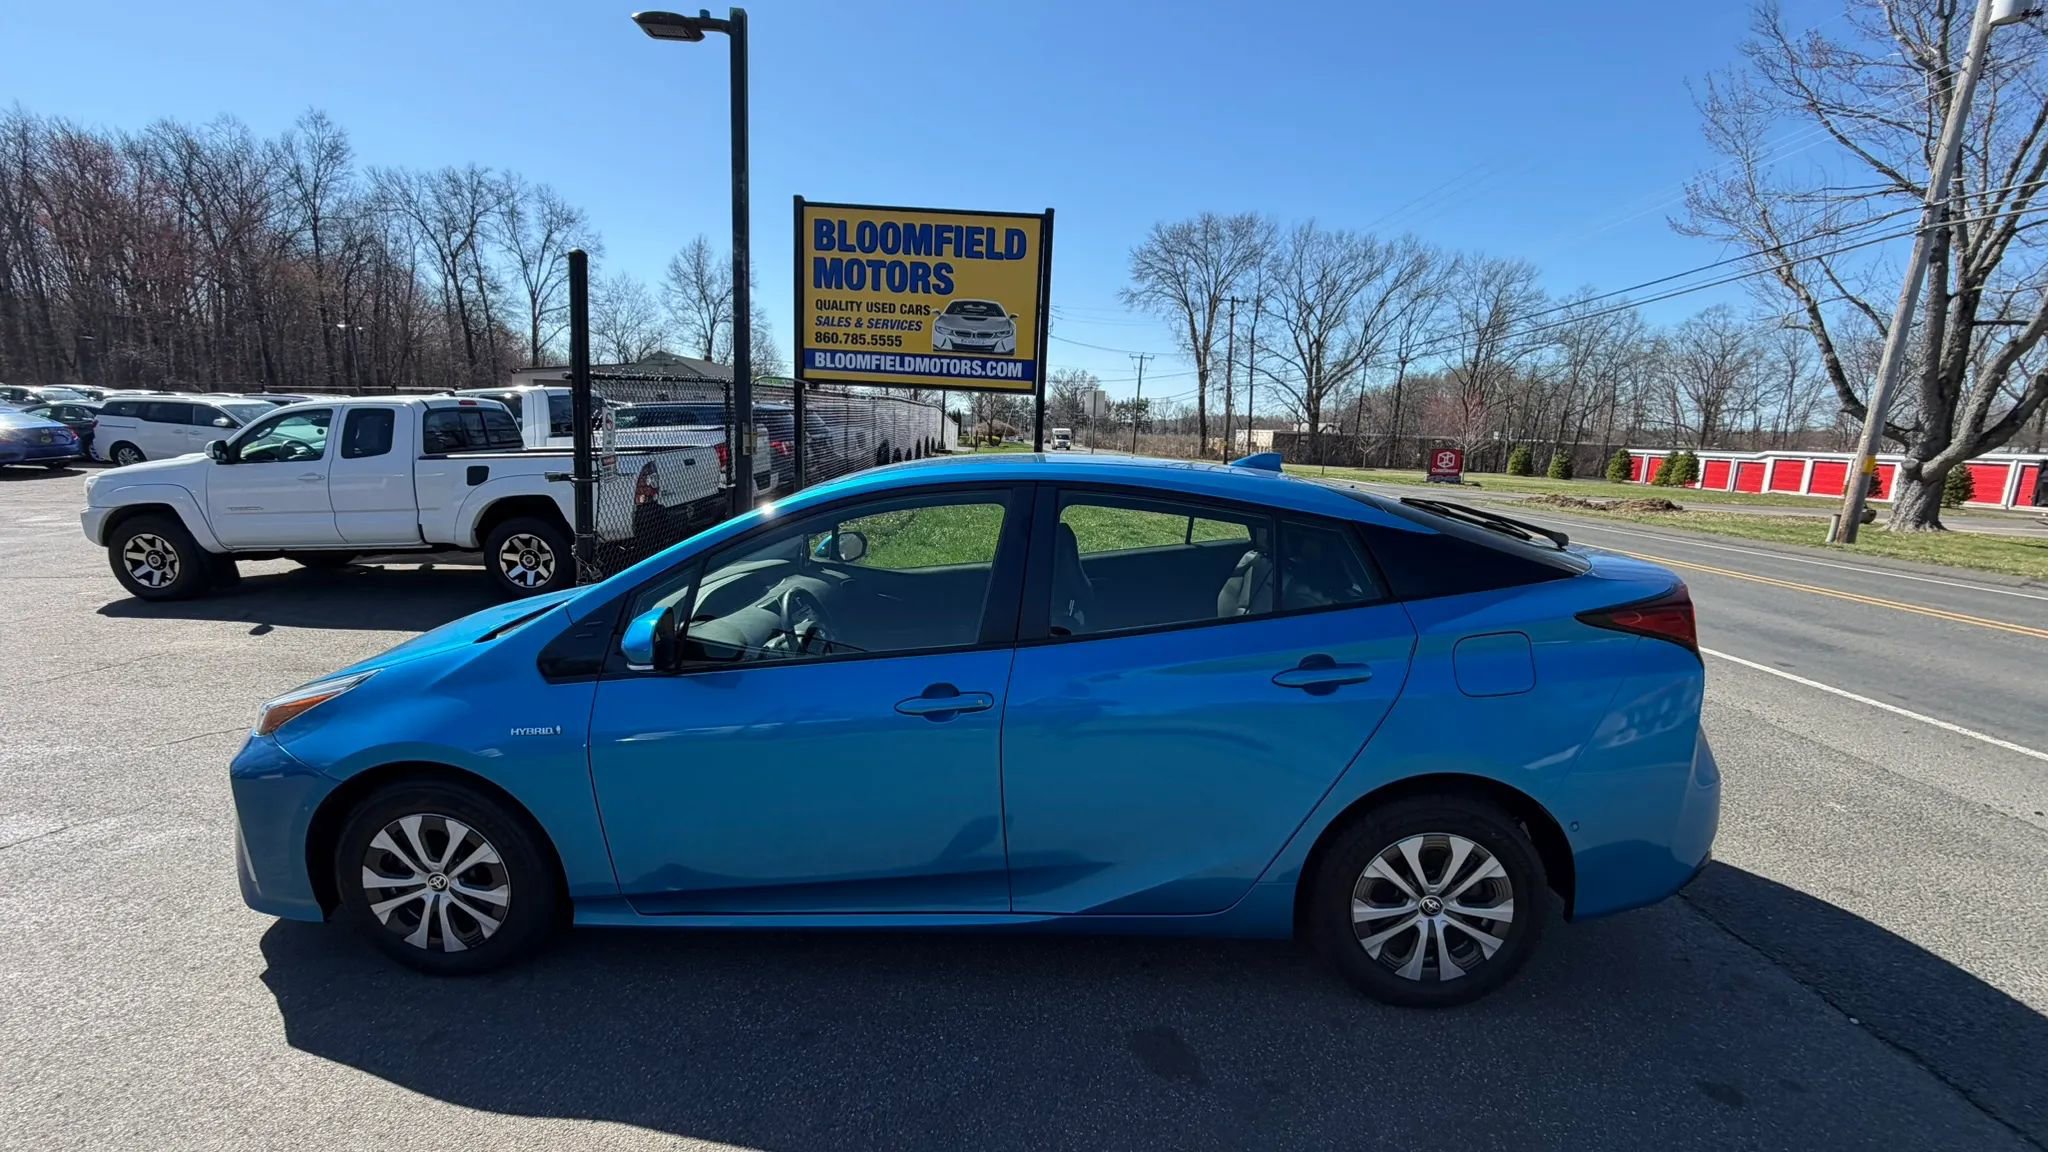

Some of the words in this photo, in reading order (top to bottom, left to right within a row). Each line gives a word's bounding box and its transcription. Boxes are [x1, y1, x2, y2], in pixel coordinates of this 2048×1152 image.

[813, 218, 1027, 260] BLOOMFIELD
[813, 257, 954, 295] MOTORS
[815, 299, 862, 312] QUALITY
[866, 302, 896, 314] USED
[900, 303, 931, 316] CARS
[815, 316, 852, 328] SALES
[854, 318, 864, 329] &
[866, 318, 923, 332] SERVICES
[815, 331, 903, 347] 860.785.5555
[814, 352, 1023, 377] BLOOMFIELDMOTORS.COM
[510, 727, 554, 736] HYBRID
